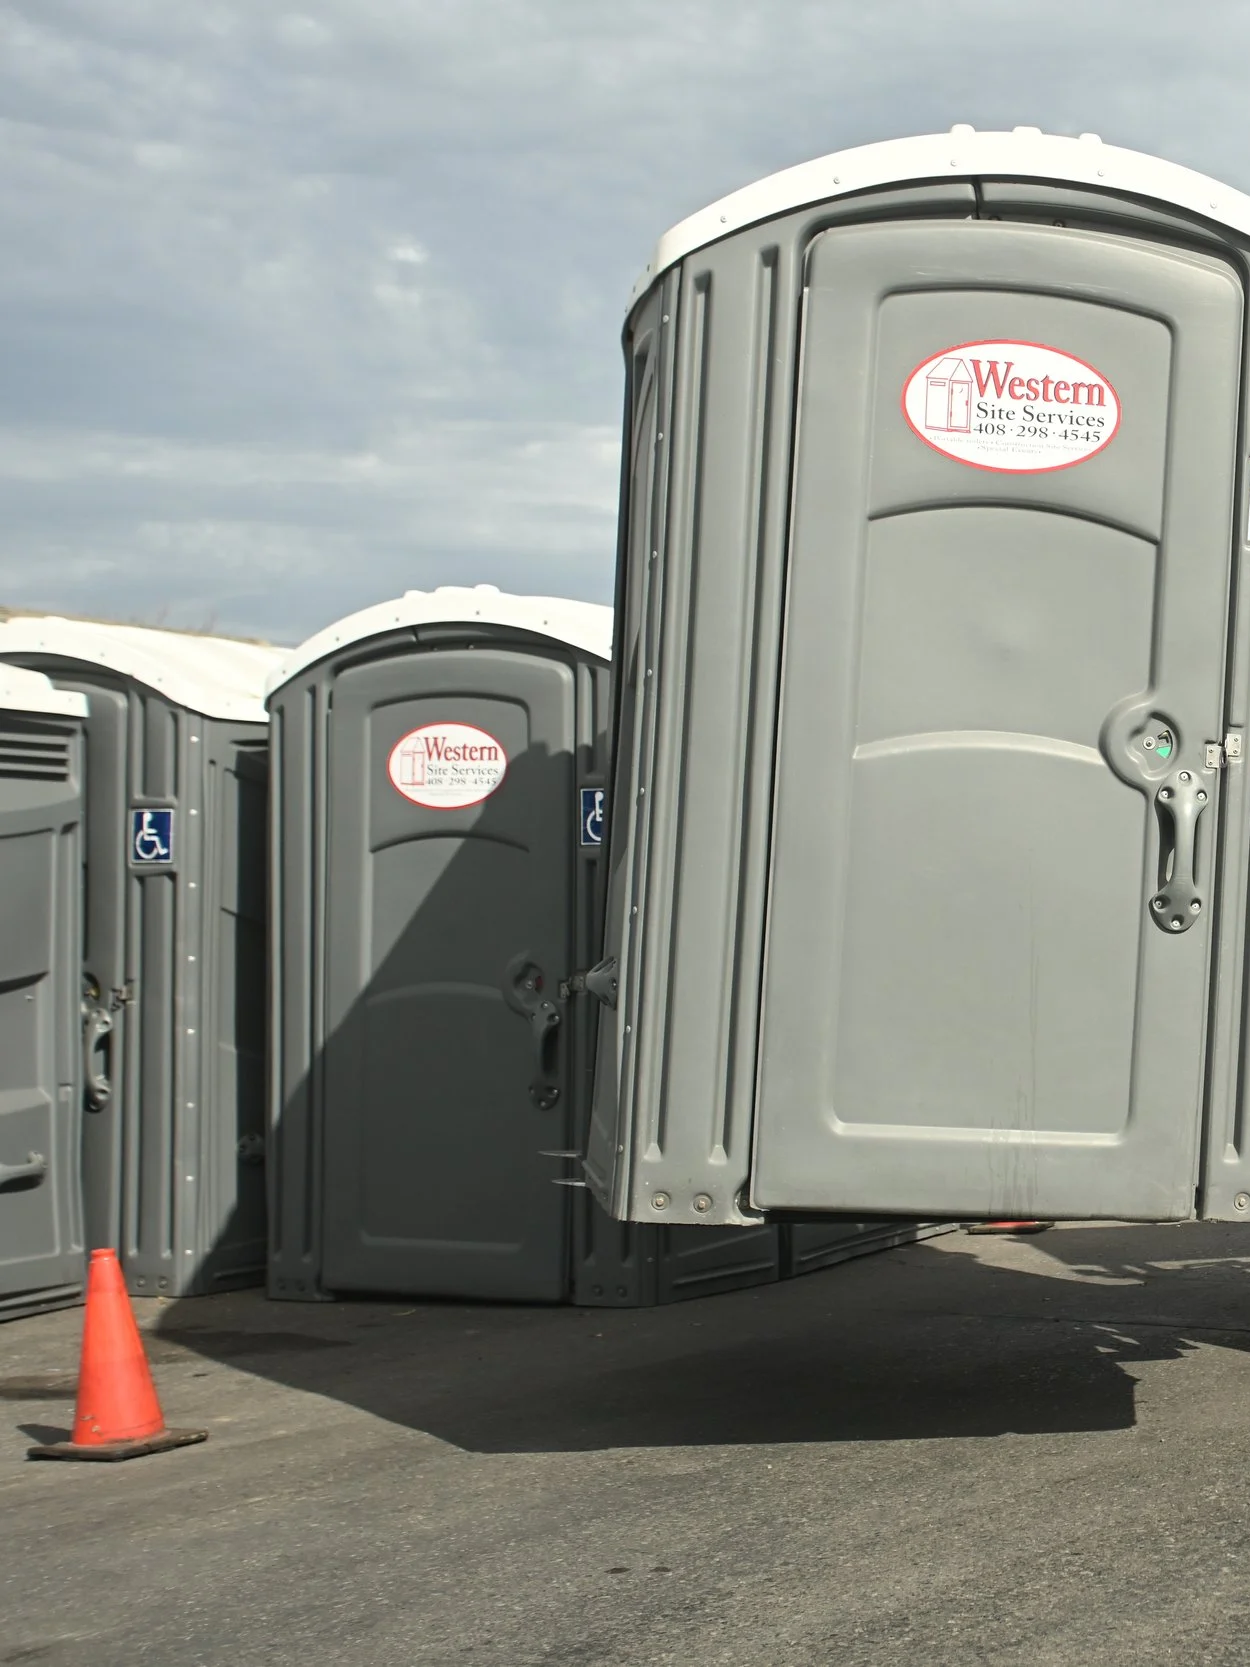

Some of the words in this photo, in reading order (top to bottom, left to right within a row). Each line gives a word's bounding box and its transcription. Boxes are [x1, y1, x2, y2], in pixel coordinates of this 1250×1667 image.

[970, 359, 1106, 407] Western
[976, 401, 1016, 421] Site
[1022, 405, 1105, 428] Services
[424, 736, 499, 762] Western
[427, 764, 448, 776] Site
[451, 764, 499, 776] Services
